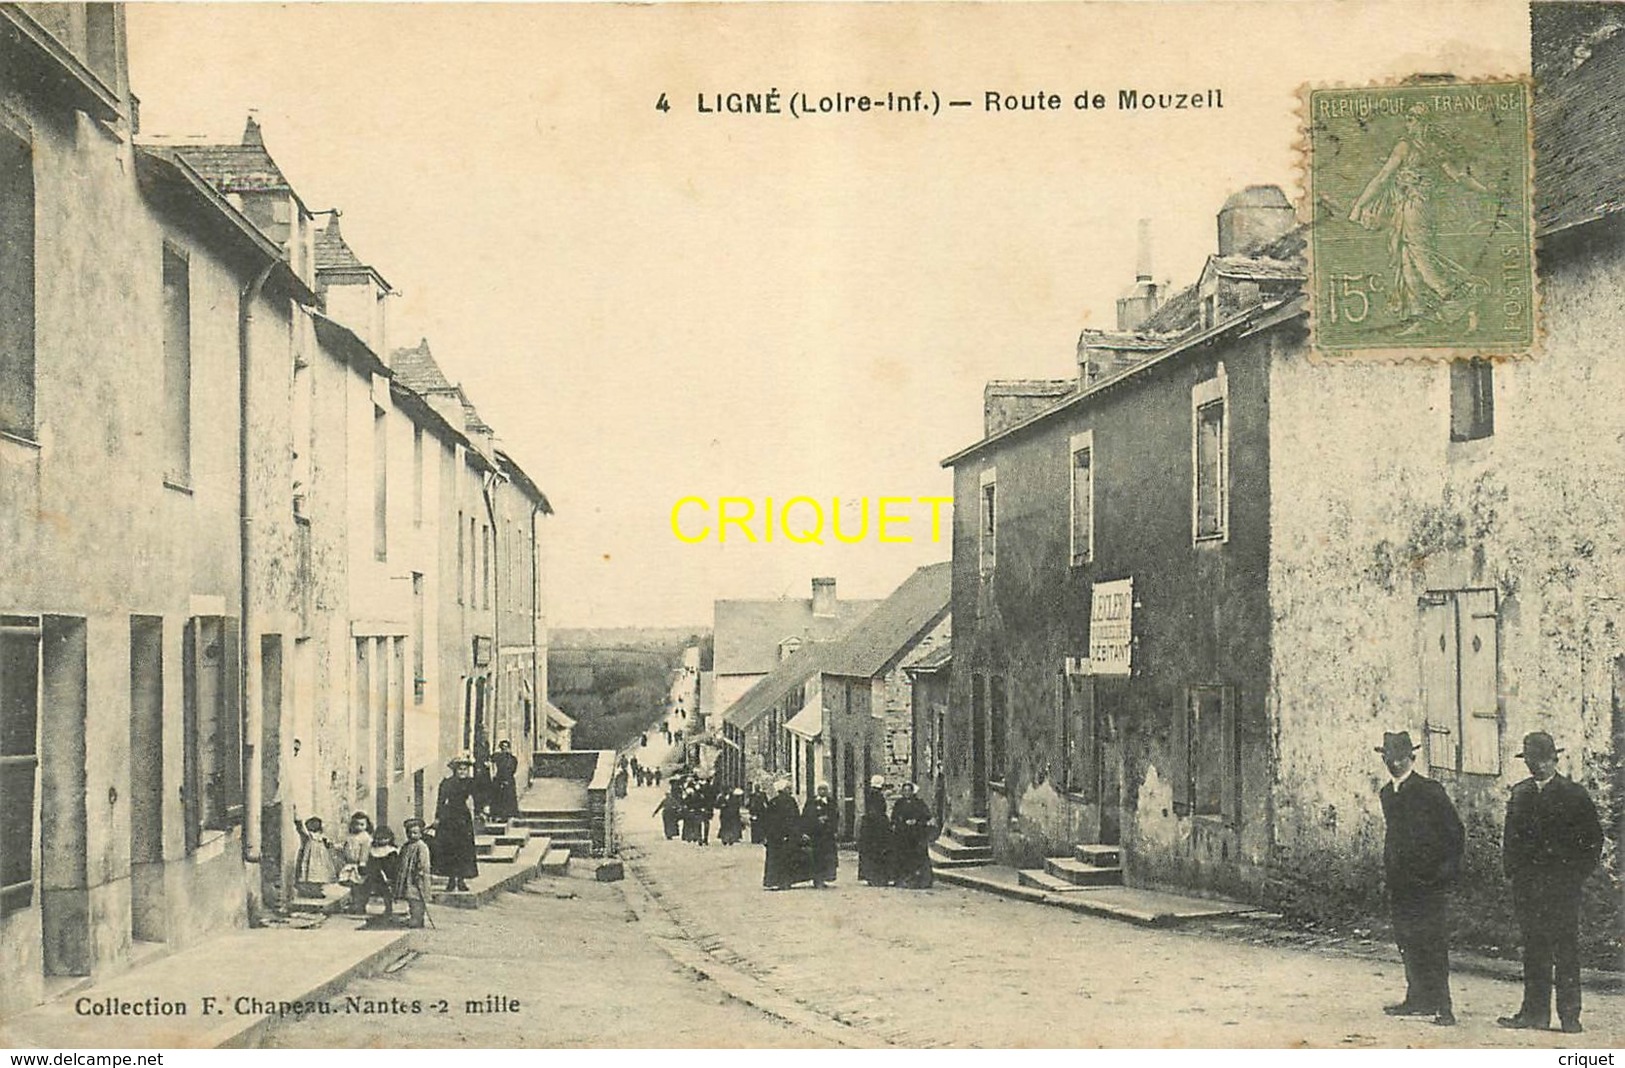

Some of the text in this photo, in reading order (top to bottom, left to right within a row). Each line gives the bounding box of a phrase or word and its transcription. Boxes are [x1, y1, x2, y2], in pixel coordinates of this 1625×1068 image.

[655, 92, 671, 113] 4
[697, 87, 781, 114] LIGNÉ
[789, 91, 940, 118] (Loire-Inf.)
[984, 91, 1062, 112] Route
[1074, 90, 1106, 110] de
[1118, 89, 1225, 110] Mouzeil
[75, 996, 187, 1017] Collection
[202, 997, 224, 1015] F.
[346, 996, 422, 1015] Nantes
[465, 996, 521, 1014] mille
